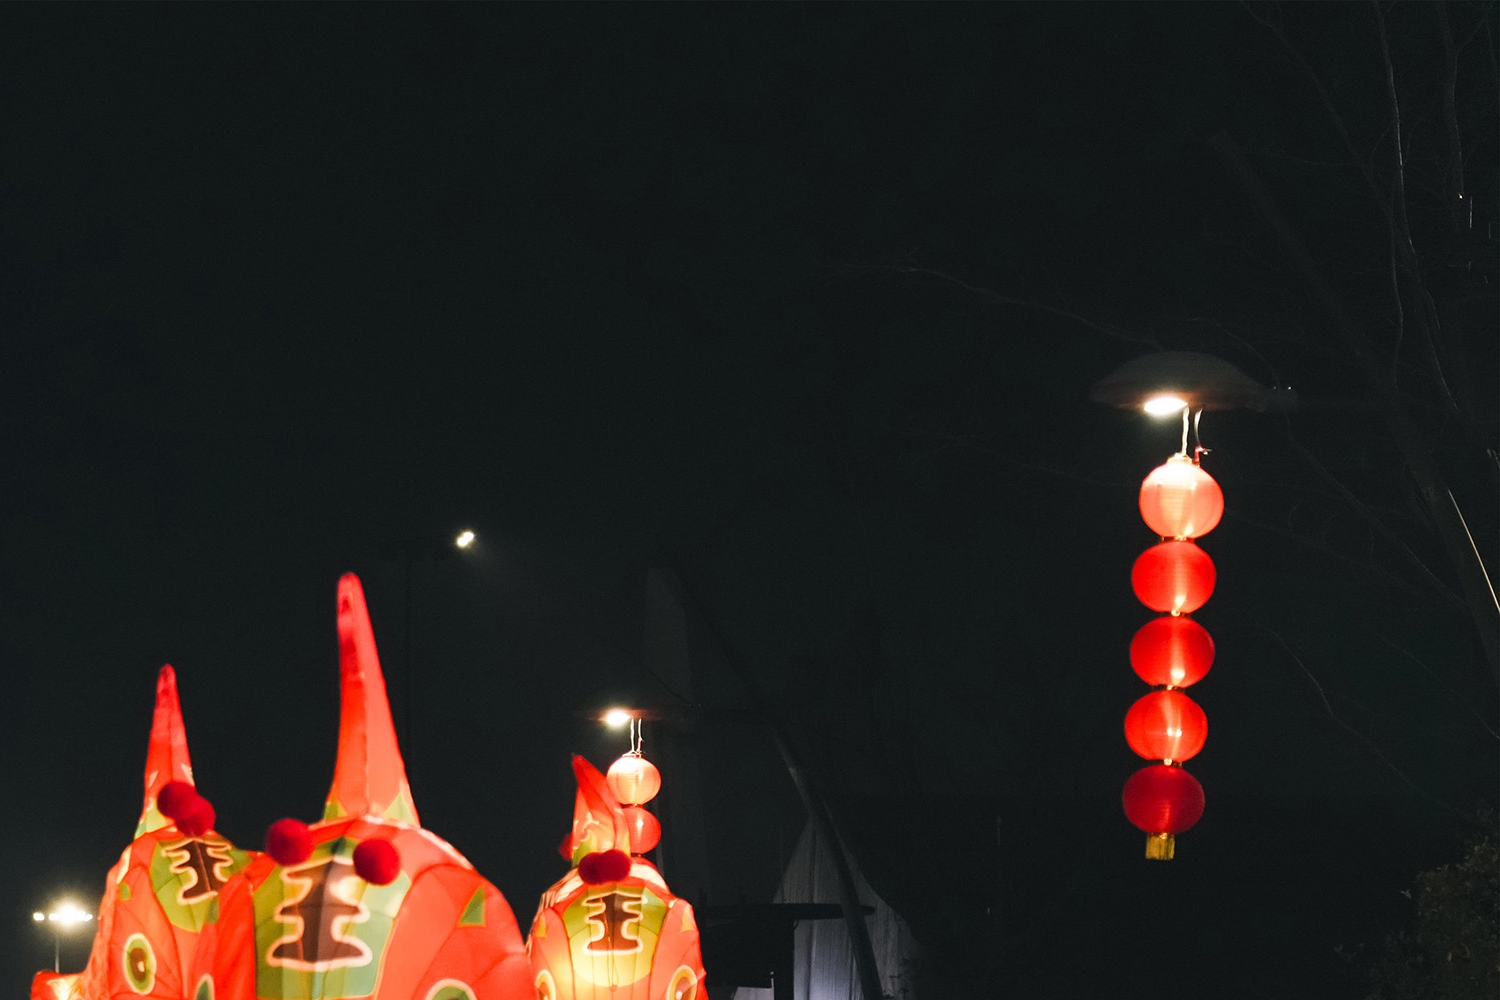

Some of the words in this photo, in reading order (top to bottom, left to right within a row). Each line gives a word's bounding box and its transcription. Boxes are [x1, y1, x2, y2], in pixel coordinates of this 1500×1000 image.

[161, 837, 234, 905] 王
[266, 855, 373, 971] 王
[581, 889, 648, 955] 王
